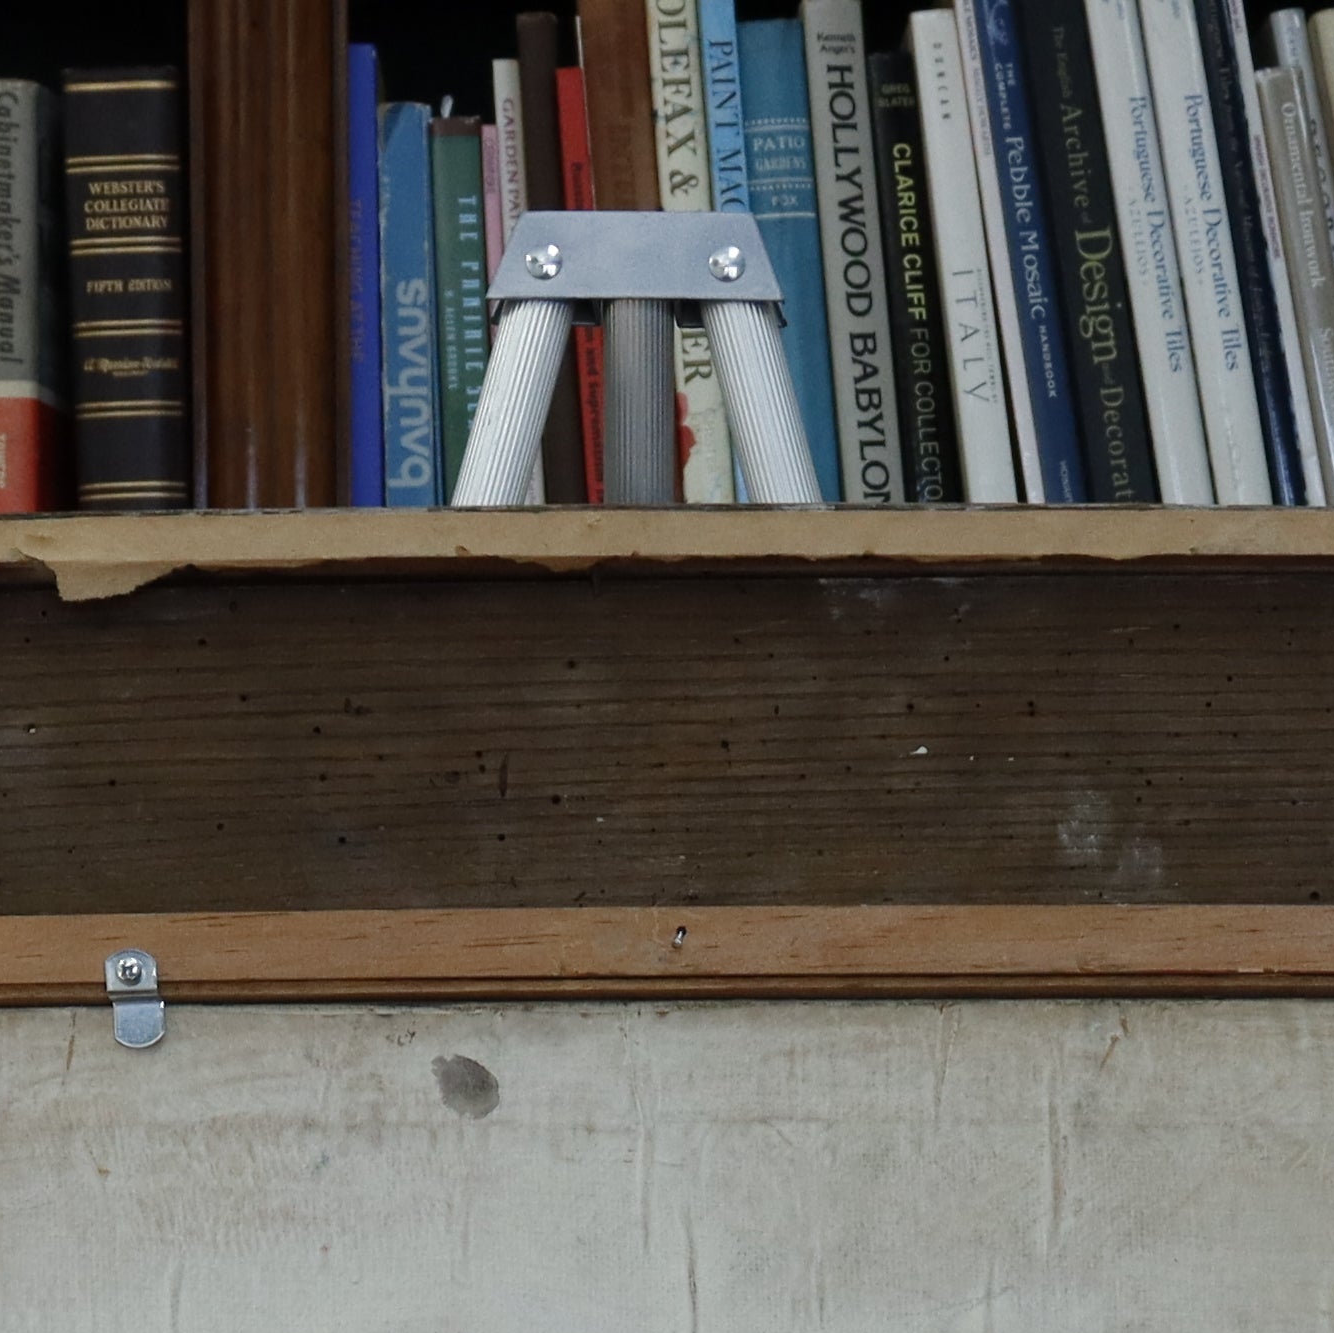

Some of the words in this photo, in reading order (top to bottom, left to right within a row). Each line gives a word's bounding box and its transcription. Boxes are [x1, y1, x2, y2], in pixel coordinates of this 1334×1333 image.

[709, 40, 740, 137] PAINT
[994, 64, 1013, 131] COMPLETE
[1004, 62, 1017, 87] THE
[502, 98, 521, 187] GARDEN
[753, 136, 806, 152] PATIO
[1004, 137, 1034, 221] Pebble
[1060, 103, 1092, 207] Archive
[84, 196, 169, 213] COLLEGIATE
[86, 214, 168, 231] DICTIONARY
[88, 180, 165, 196] WEBSTER'S
[458, 195, 478, 241] THE
[827, 63, 874, 318] HOLLYWOOD
[893, 143, 920, 247] CLARICE
[1280, 102, 1314, 205] Ornamental
[1297, 208, 1326, 288] Ironwork
[1017, 230, 1048, 319] Mosaic
[1128, 95, 1158, 204] Portuguese
[1143, 208, 1175, 319] Decorative
[1162, 325, 1185, 373] Tiles
[1184, 94, 1214, 205] Portuguese
[1200, 208, 1231, 317] Decorative
[1219, 323, 1240, 372] Tiles
[87, 278, 122, 293] FIFTH
[128, 277, 172, 293] EDITION
[903, 252, 928, 321] CLIFF
[1074, 226, 1124, 365] Design
[910, 324, 931, 374] FOR
[952, 267, 990, 402] ITALY
[1037, 324, 1059, 397] HANDBOOK
[1098, 385, 1135, 500] Decorat
